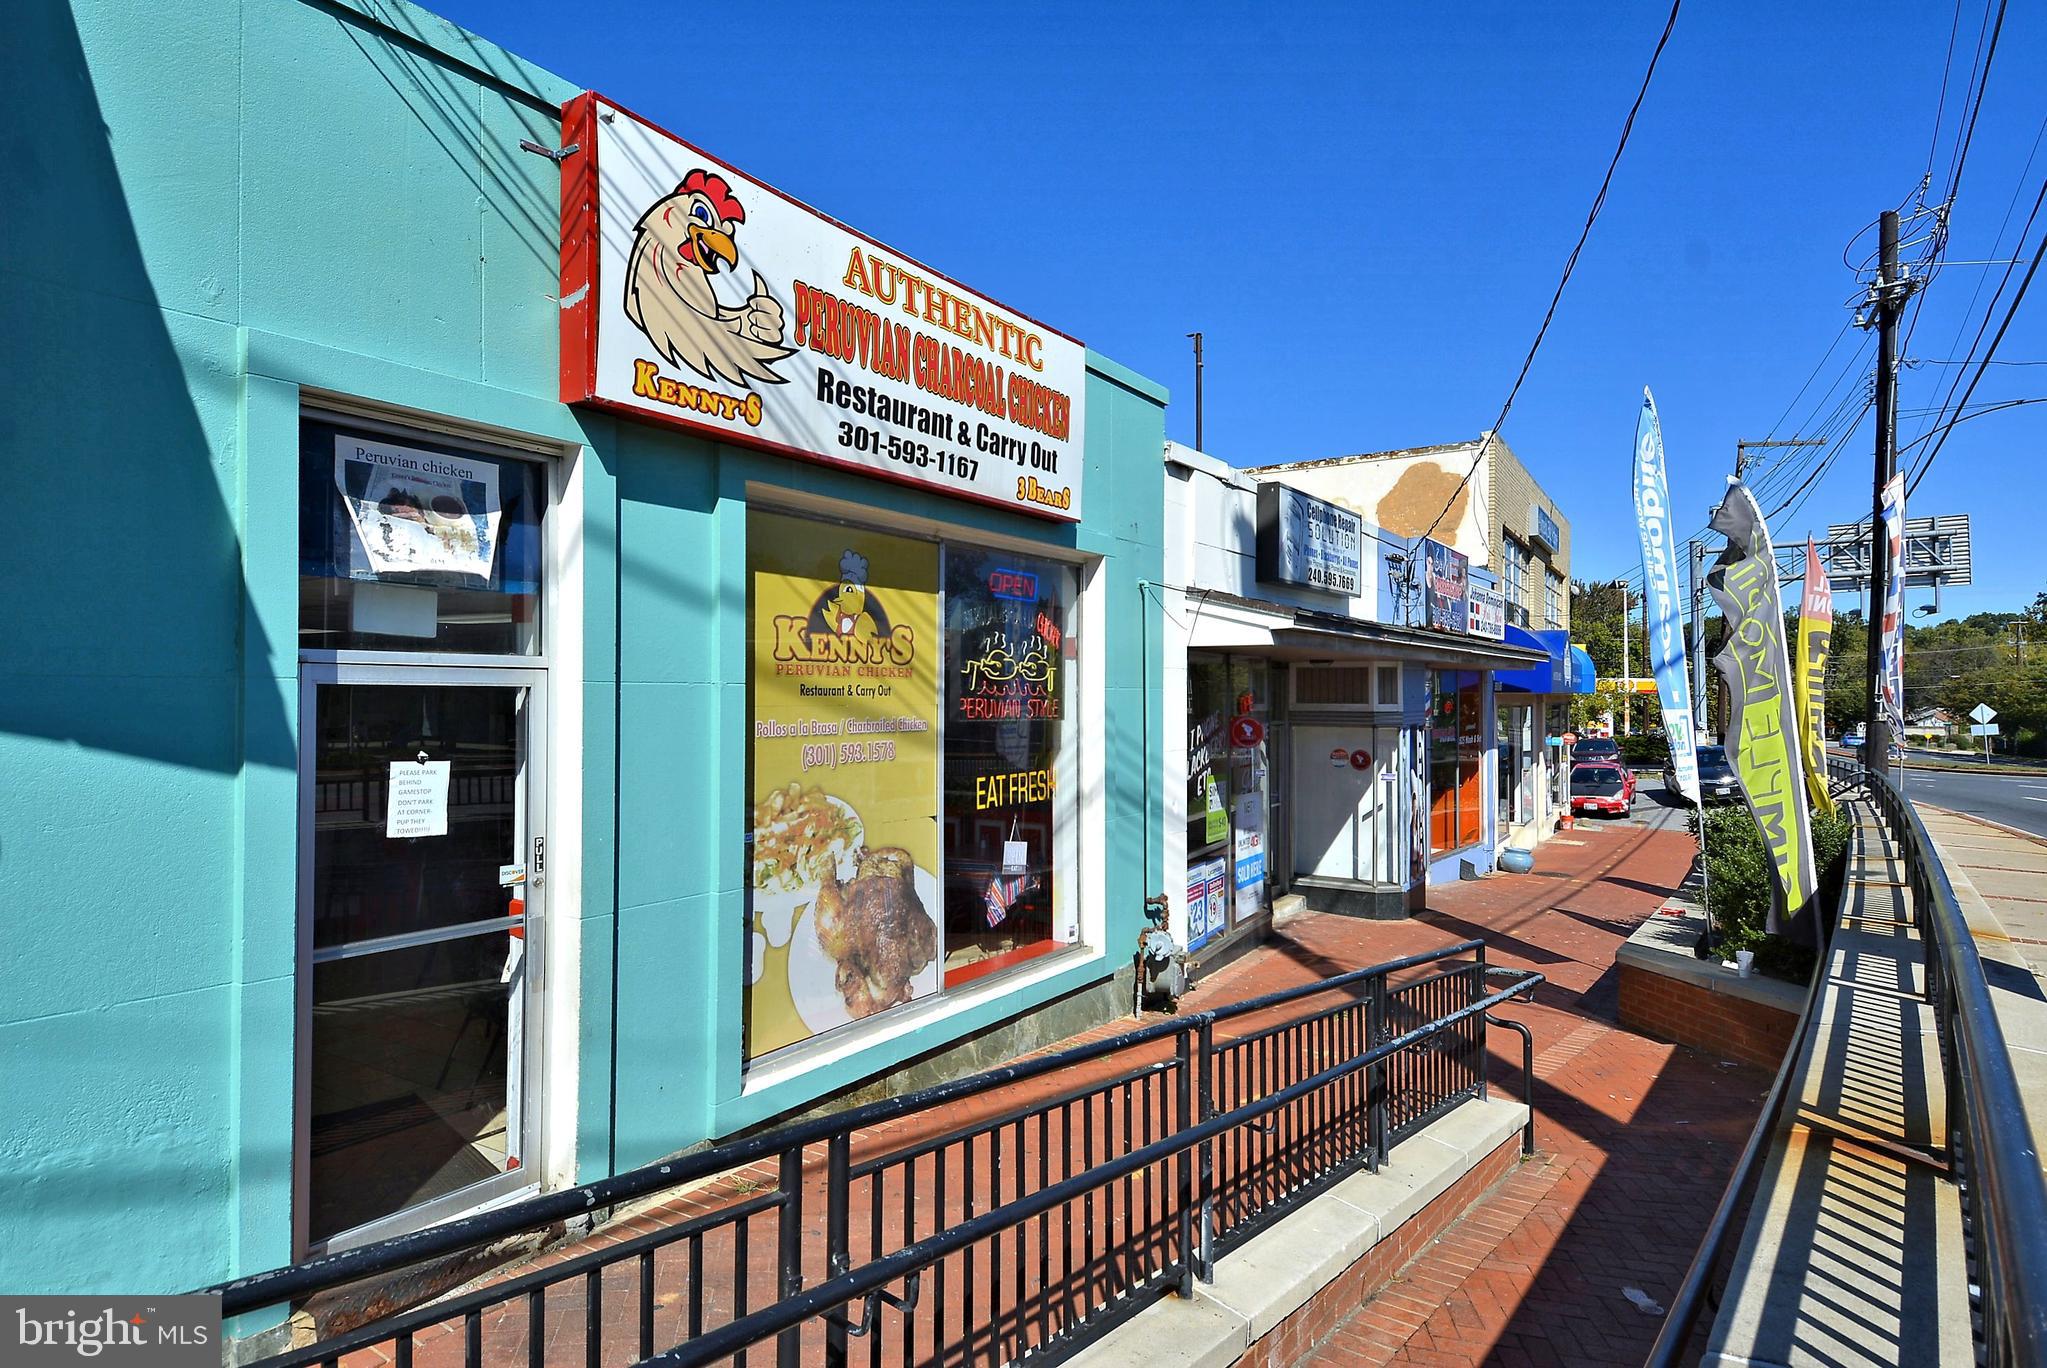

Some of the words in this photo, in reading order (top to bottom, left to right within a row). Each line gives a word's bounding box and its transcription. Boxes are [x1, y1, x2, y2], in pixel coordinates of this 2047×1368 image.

[844, 247, 1044, 372] AUTHENTIC
[793, 280, 911, 384] PERUVIAN
[913, 332, 1005, 419] CHARCOAL
[1007, 371, 1071, 443] CHICKEN
[634, 360, 762, 427] KENNY'S
[816, 368, 954, 442] Restaurant
[958, 421, 973, 448] &
[976, 425, 1027, 467] Carry
[1030, 441, 1058, 476] Out
[355, 447, 418, 470] Peruvian
[422, 460, 473, 480] chicken
[838, 421, 979, 482] 301-593-1167
[1016, 476, 1026, 501] 3
[1027, 478, 1071, 511] BEARS
[1307, 521, 1356, 551] SOLUTION
[989, 572, 1035, 597] OPEN
[773, 614, 914, 666] KENNY'S
[776, 664, 851, 678] PERUVIAN
[857, 666, 913, 679] CHICKEN
[799, 683, 845, 698] Restaurant
[847, 685, 853, 697] &
[855, 684, 876, 700] Carry
[877, 685, 891, 698] Out
[960, 697, 1021, 720] PERUVIAN
[1026, 698, 1059, 719] STYLE
[756, 722, 786, 738] Pollos
[788, 725, 797, 737] a
[798, 721, 809, 736] la
[811, 721, 838, 735] Brasa
[846, 718, 897, 734] Charbroiled
[898, 718, 928, 733] Chicken
[801, 743, 836, 772] (301)
[839, 739, 896, 765] 593.1578
[398, 788, 432, 796] GAMESTOP
[976, 774, 1006, 810] EAT
[1009, 768, 1057, 806] FRESH
[535, 838, 544, 872] PULL
[501, 868, 524, 877] DISCOVER
[1237, 865, 1250, 884] SOLD
